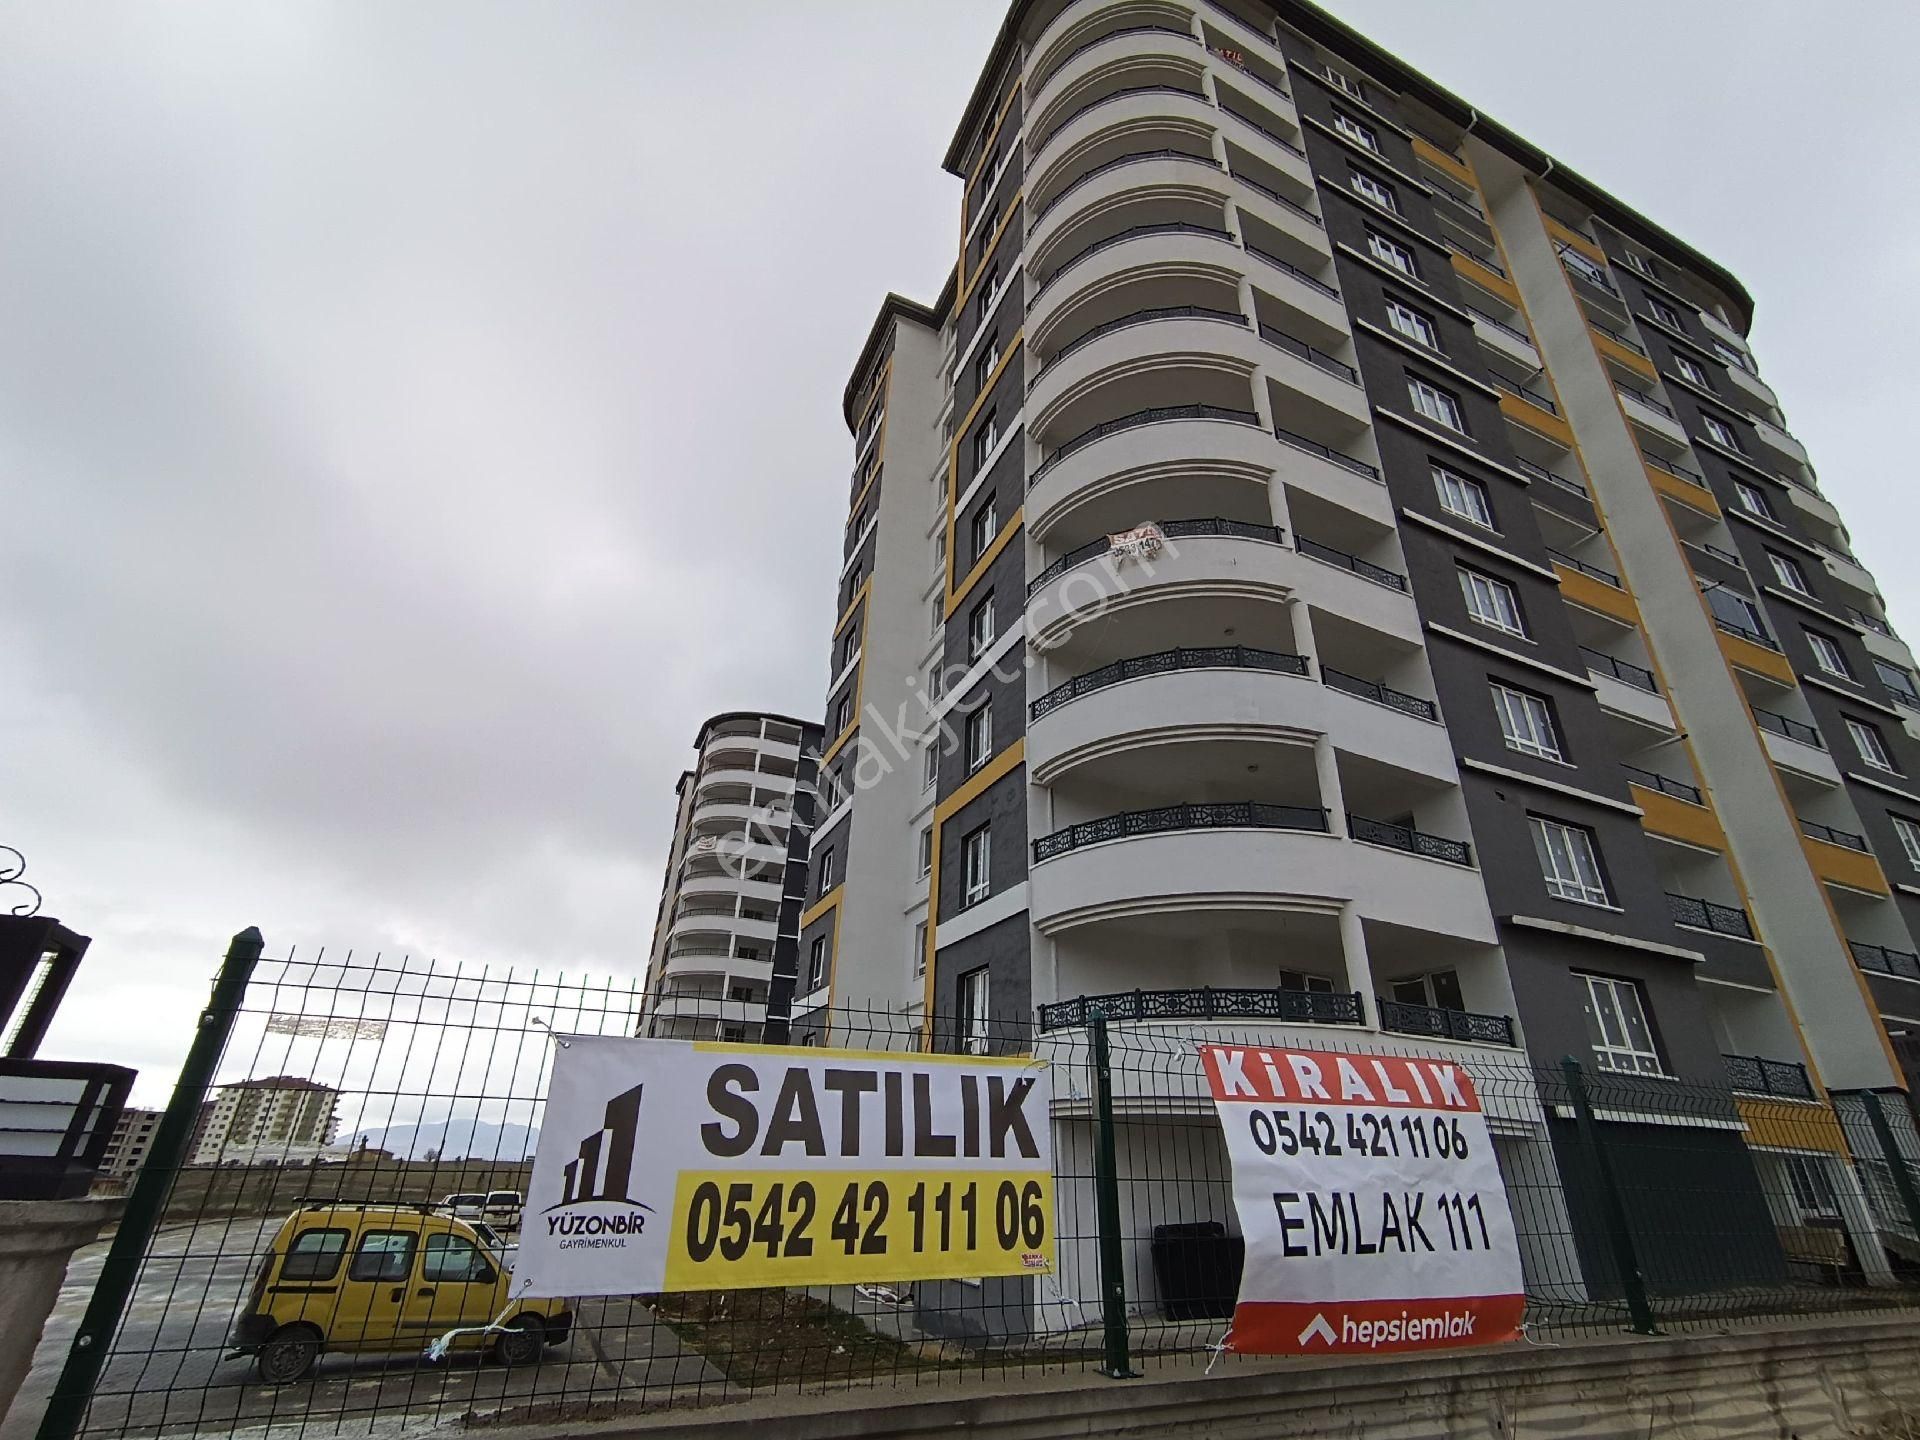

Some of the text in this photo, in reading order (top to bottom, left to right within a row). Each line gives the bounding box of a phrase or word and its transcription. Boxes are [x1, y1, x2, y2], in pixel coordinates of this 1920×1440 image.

[700, 1063, 1041, 1159] SATILIK
[1249, 1109, 1343, 1156] 0542
[1433, 1116, 1469, 1160] 06
[547, 1211, 645, 1236] YÜZONBİR
[559, 1238, 628, 1250] GAYRİMENKUL
[686, 1179, 1045, 1263] 0542 42 111 06
[1272, 1191, 1491, 1258] EMLAK 111
[1341, 1311, 1476, 1347] hepsiemlak
